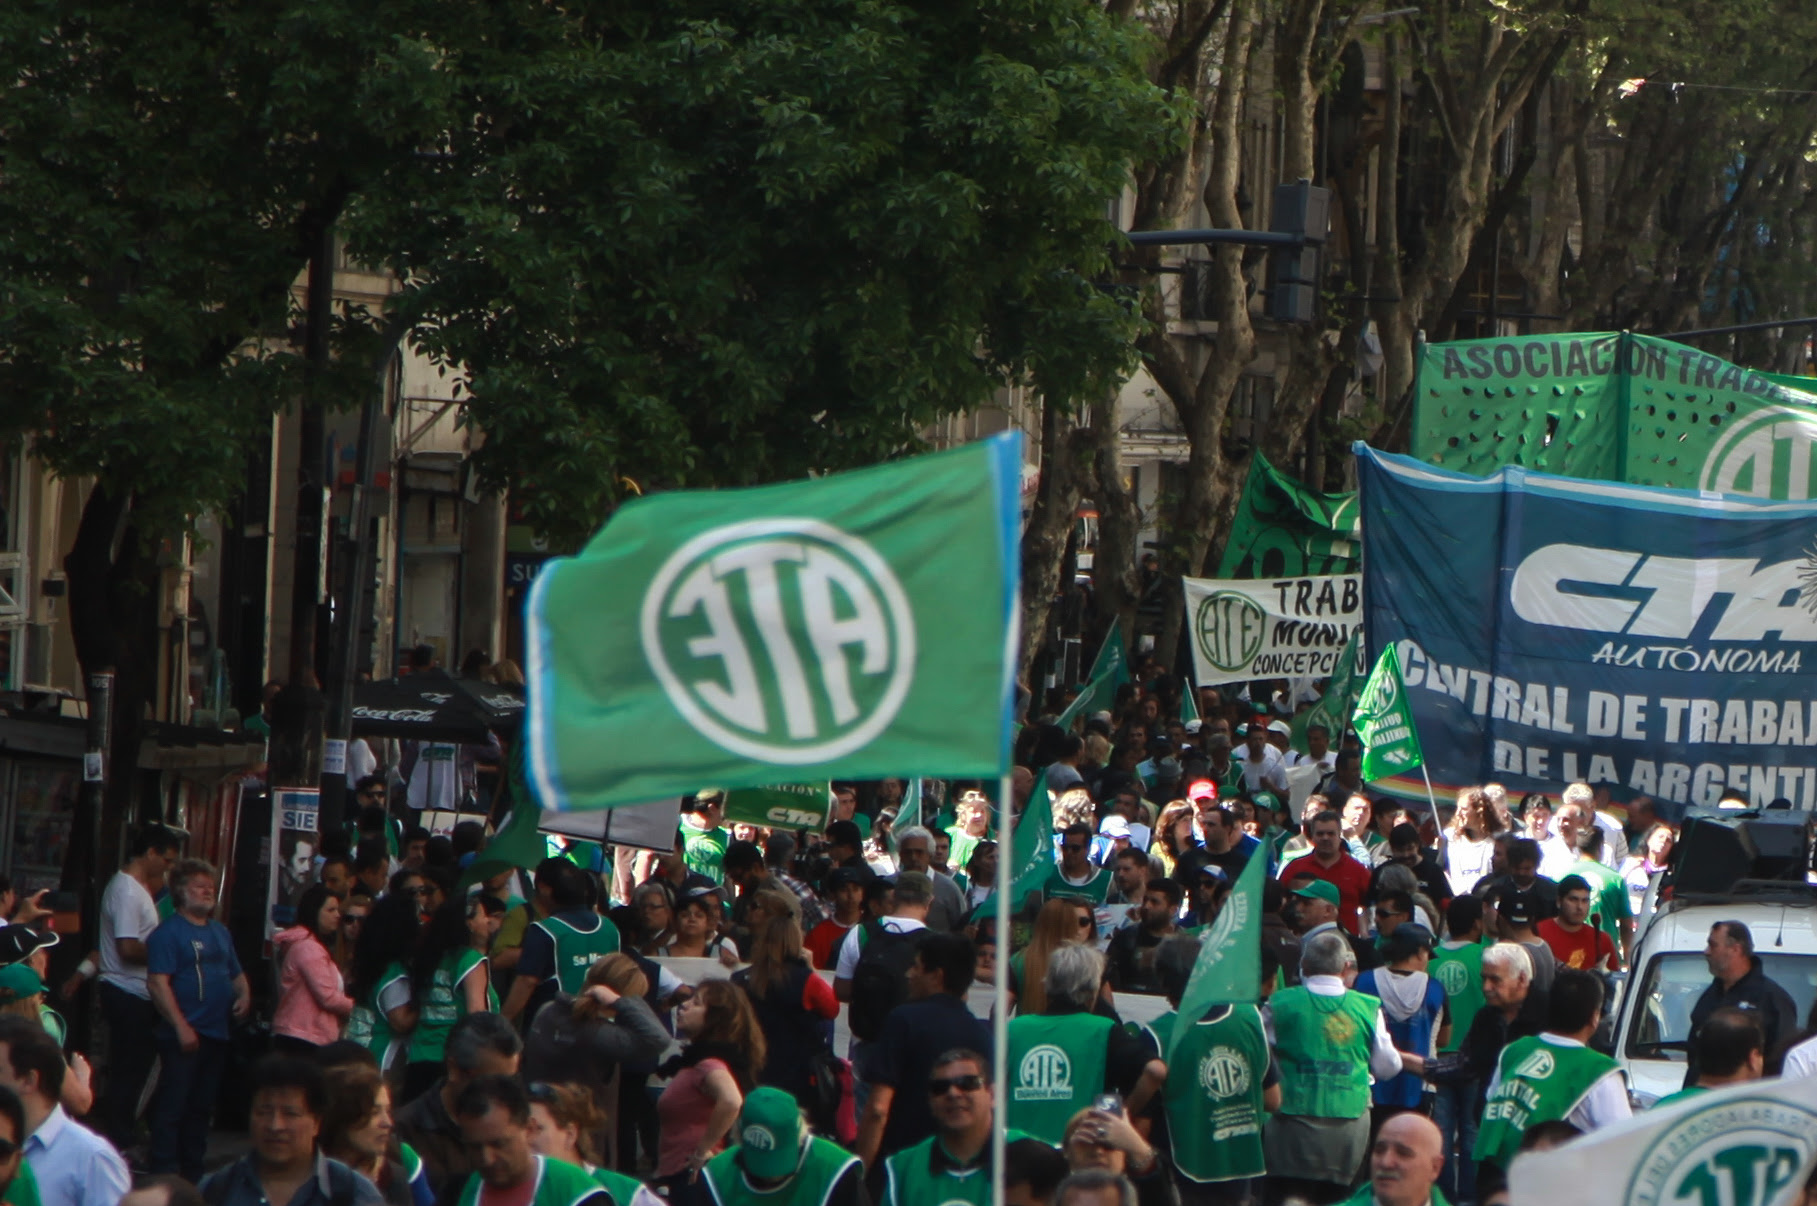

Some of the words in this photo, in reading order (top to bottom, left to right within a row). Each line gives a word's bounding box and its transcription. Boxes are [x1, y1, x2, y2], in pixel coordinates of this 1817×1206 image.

[1200, 597, 1262, 667] ATE
[1592, 641, 1801, 674] AUTÓNOMA
[1397, 638, 1576, 735] CENTRAL
[1588, 690, 1648, 737] DE
